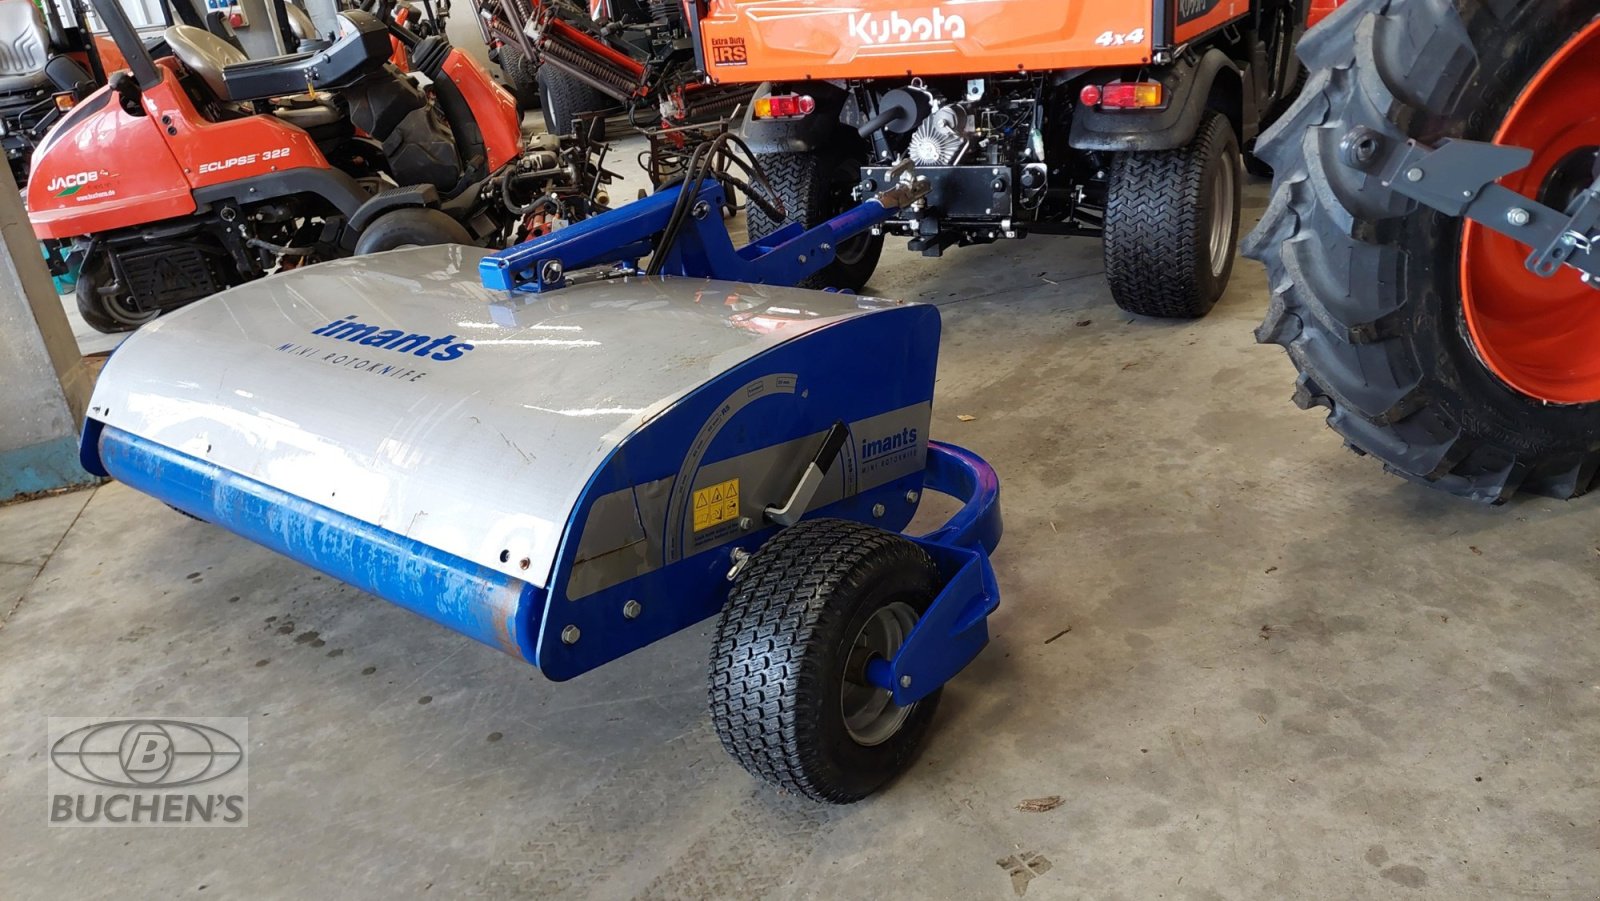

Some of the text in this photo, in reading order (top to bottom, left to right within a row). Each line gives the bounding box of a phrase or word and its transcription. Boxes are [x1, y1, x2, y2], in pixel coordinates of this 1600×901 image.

[729, 36, 744, 44] Duty
[849, 7, 965, 44] Kubota
[1095, 28, 1145, 46] 4x4
[714, 46, 746, 62] IRS
[199, 147, 290, 174] ECLIPSE 322
[311, 315, 475, 361] imants
[276, 342, 427, 382] MINI ROTOKNIFE
[862, 427, 917, 458] imants
